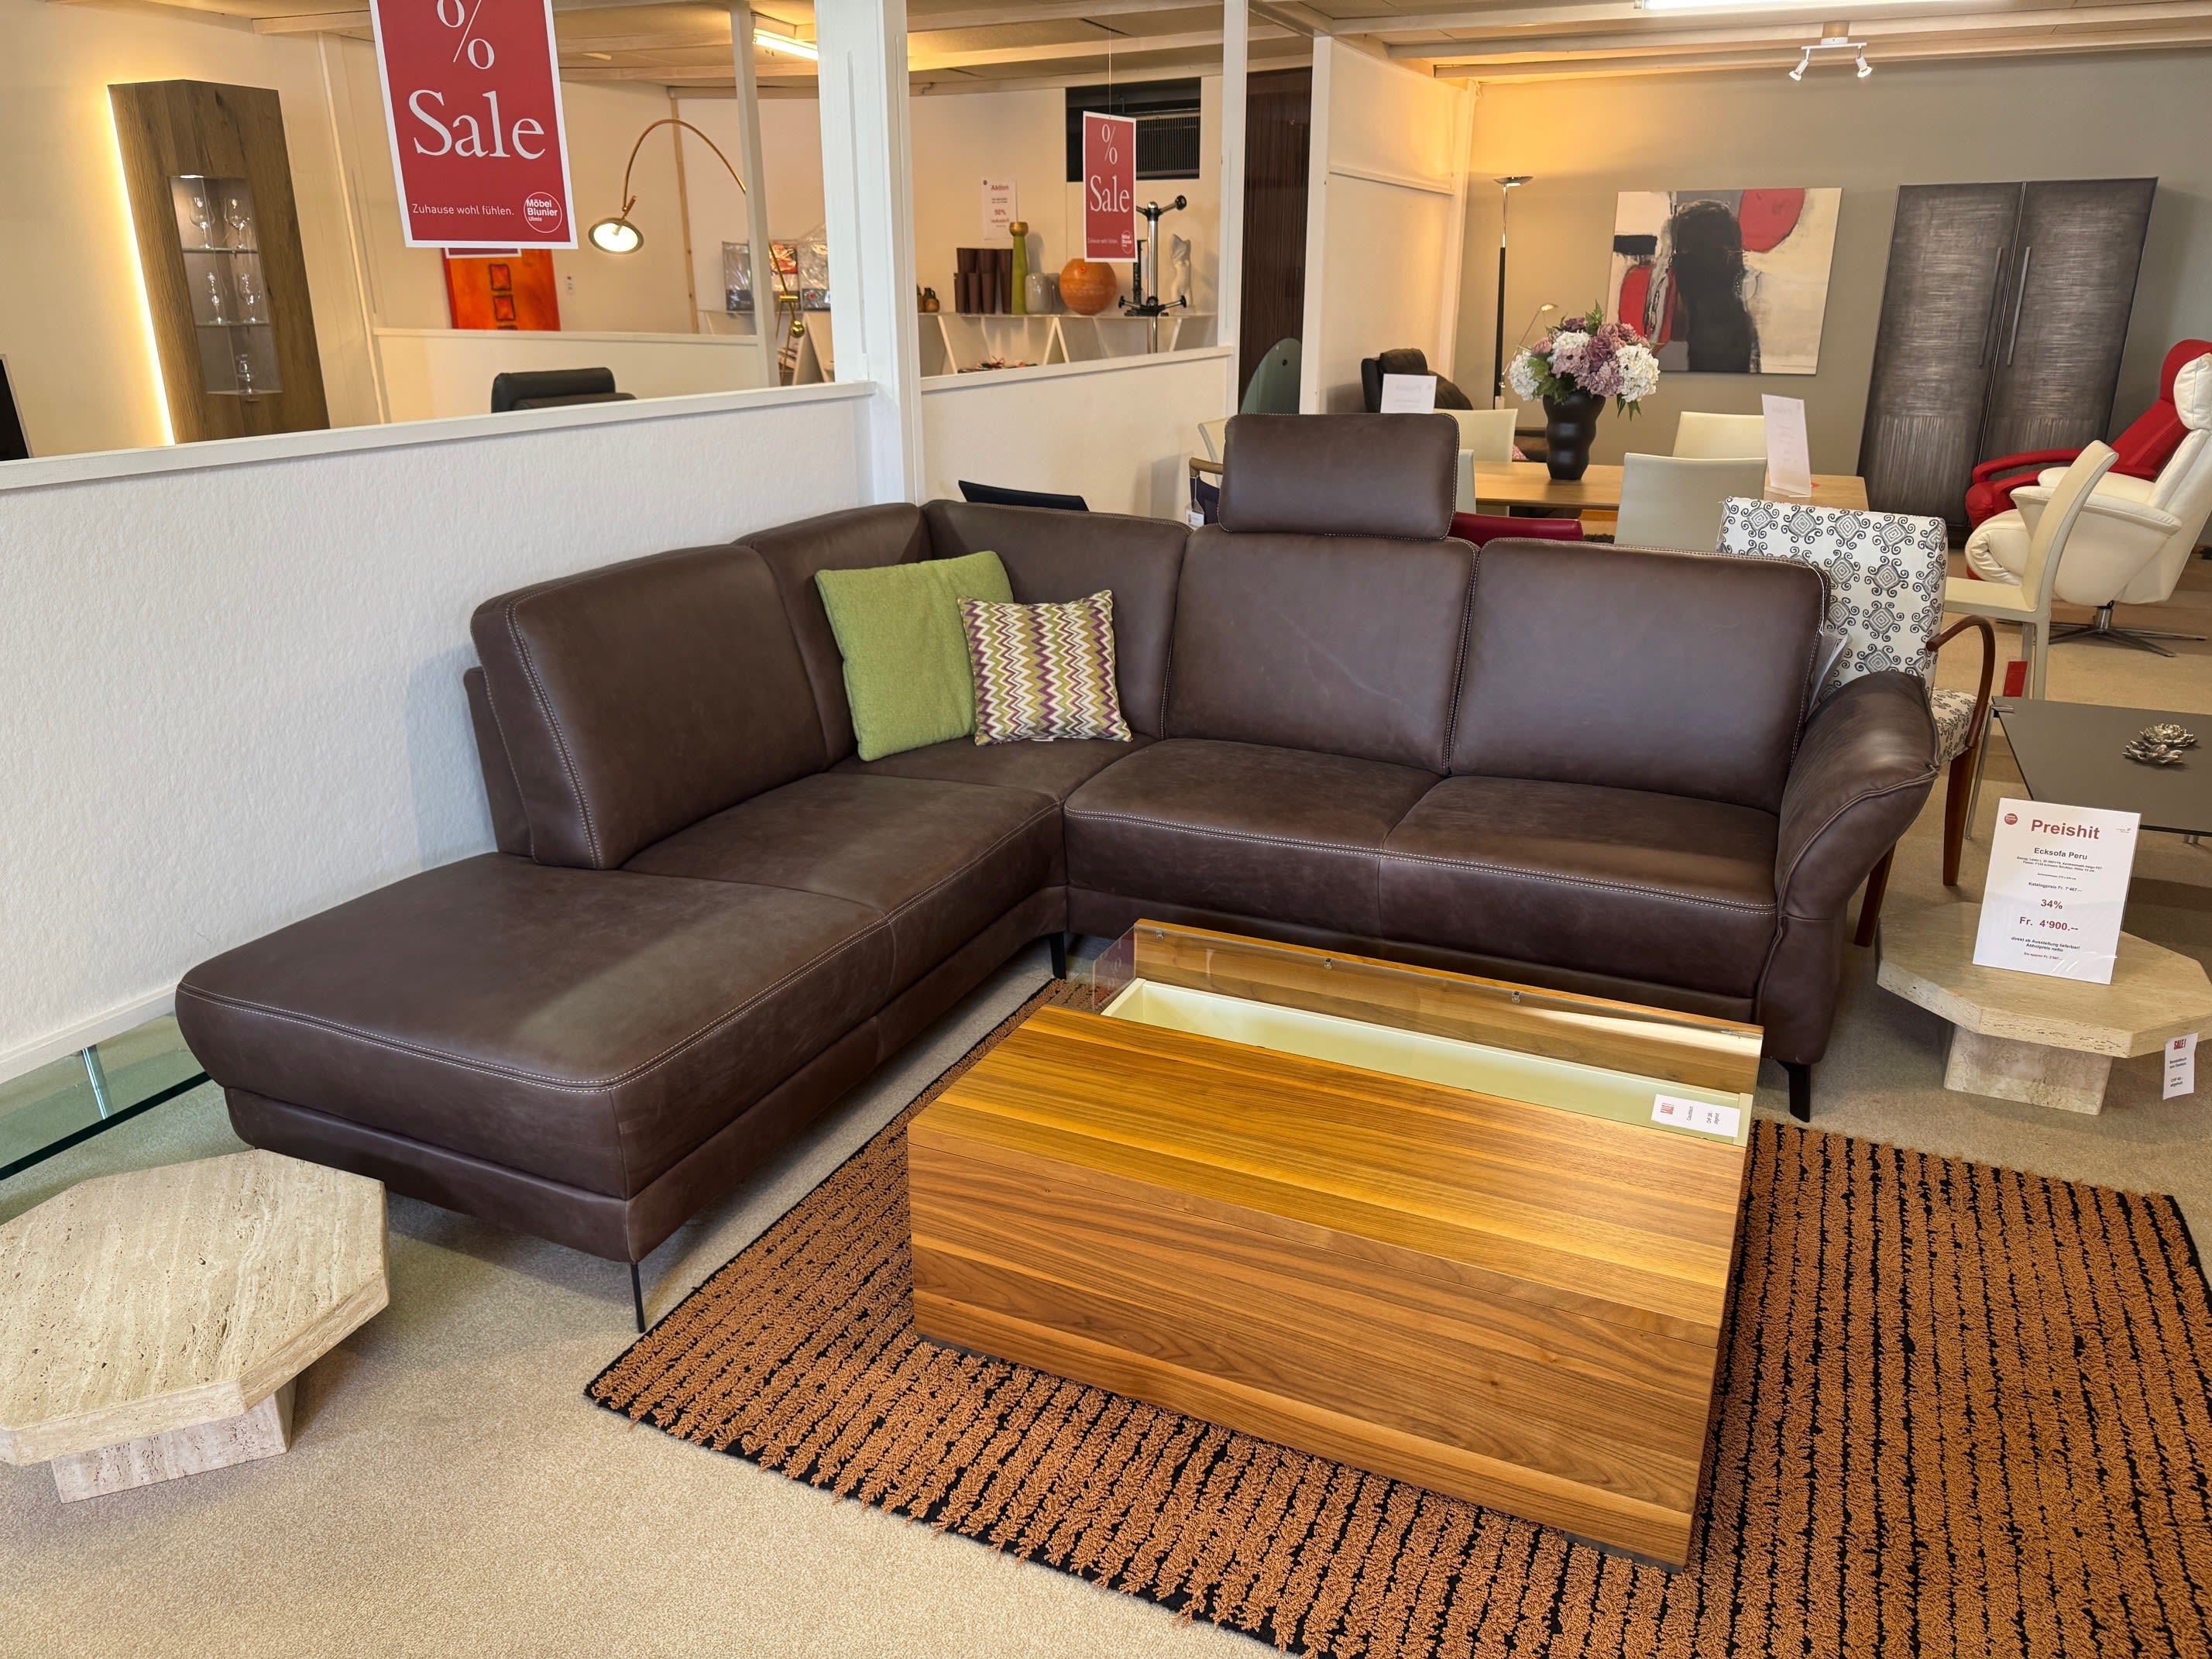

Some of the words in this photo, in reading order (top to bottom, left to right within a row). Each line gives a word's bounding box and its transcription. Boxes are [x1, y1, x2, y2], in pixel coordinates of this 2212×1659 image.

[408, 89, 546, 160] Sale
[1101, 124, 1118, 165] %
[1090, 174, 1130, 214] Sale
[527, 199, 552, 208] Möbel
[412, 204, 455, 215] Zuhause
[456, 205, 480, 215] wohl
[482, 205, 514, 216] fühlen.
[527, 208, 558, 216] Blunier
[2031, 819, 2100, 840] Preishit
[2034, 847, 2066, 857] Ecksofa
[2068, 852, 2088, 860] Peru
[2041, 899, 2063, 910] 34%
[2019, 916, 2033, 926] Fr.
